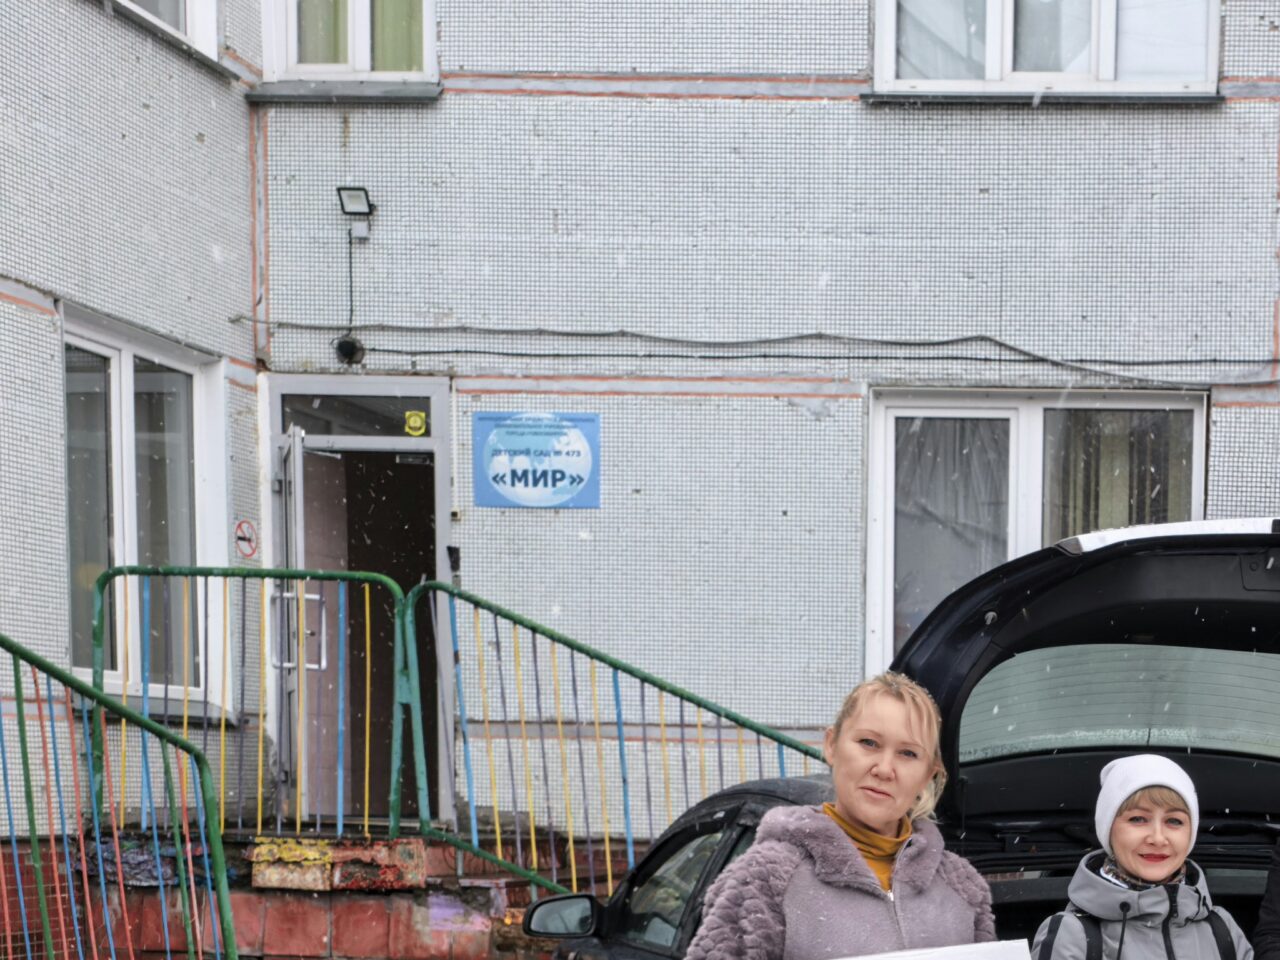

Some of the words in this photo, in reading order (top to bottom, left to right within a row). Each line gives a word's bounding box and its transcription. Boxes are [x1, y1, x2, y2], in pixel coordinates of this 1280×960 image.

[492, 448, 531, 458] ДЕТСКИЙ
[533, 449, 551, 458] САД
[565, 450, 582, 458] 473
[491, 468, 585, 488] «МИР»
